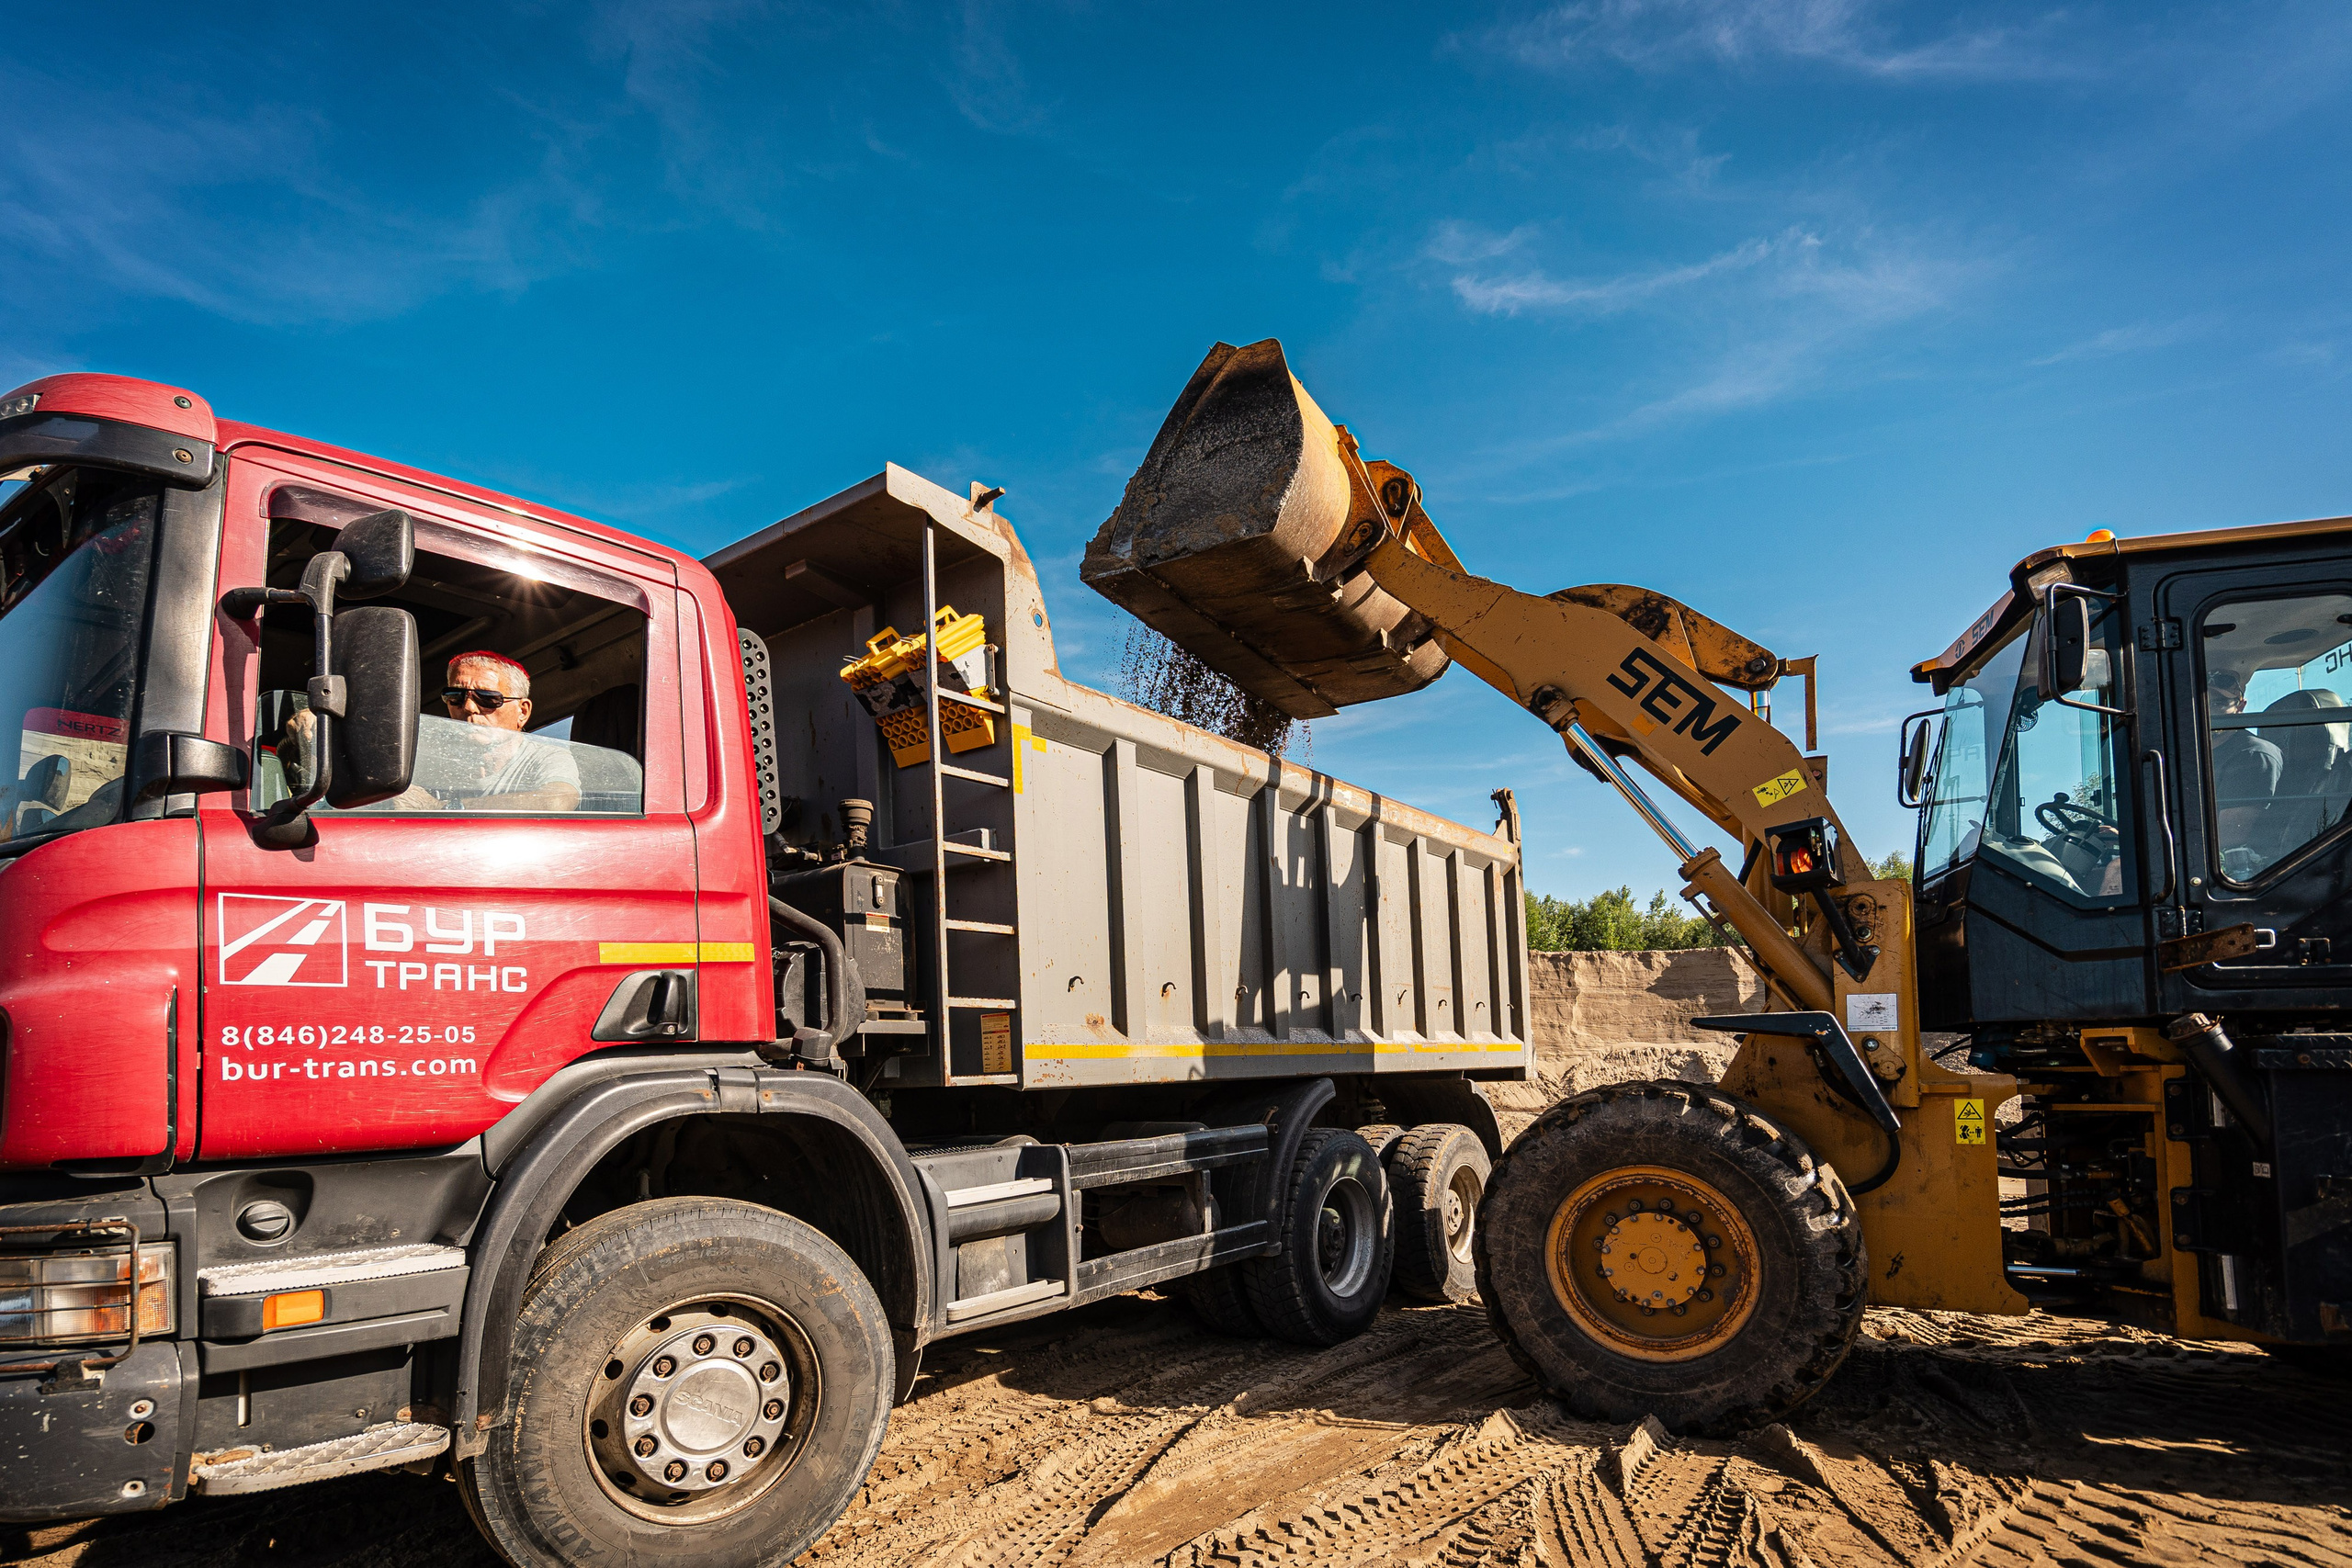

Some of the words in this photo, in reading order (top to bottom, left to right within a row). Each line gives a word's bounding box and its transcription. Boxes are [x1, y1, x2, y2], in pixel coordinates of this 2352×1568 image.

[1972, 608, 1995, 646] SEM
[1606, 647, 1742, 756] SEM
[364, 902, 526, 956] БУР
[365, 960, 527, 993] ТРАНС
[221, 1025, 477, 1050] 8(846)248-25-05
[221, 1055, 477, 1081] bur-trans.com
[674, 1390, 744, 1427] SCANIA
